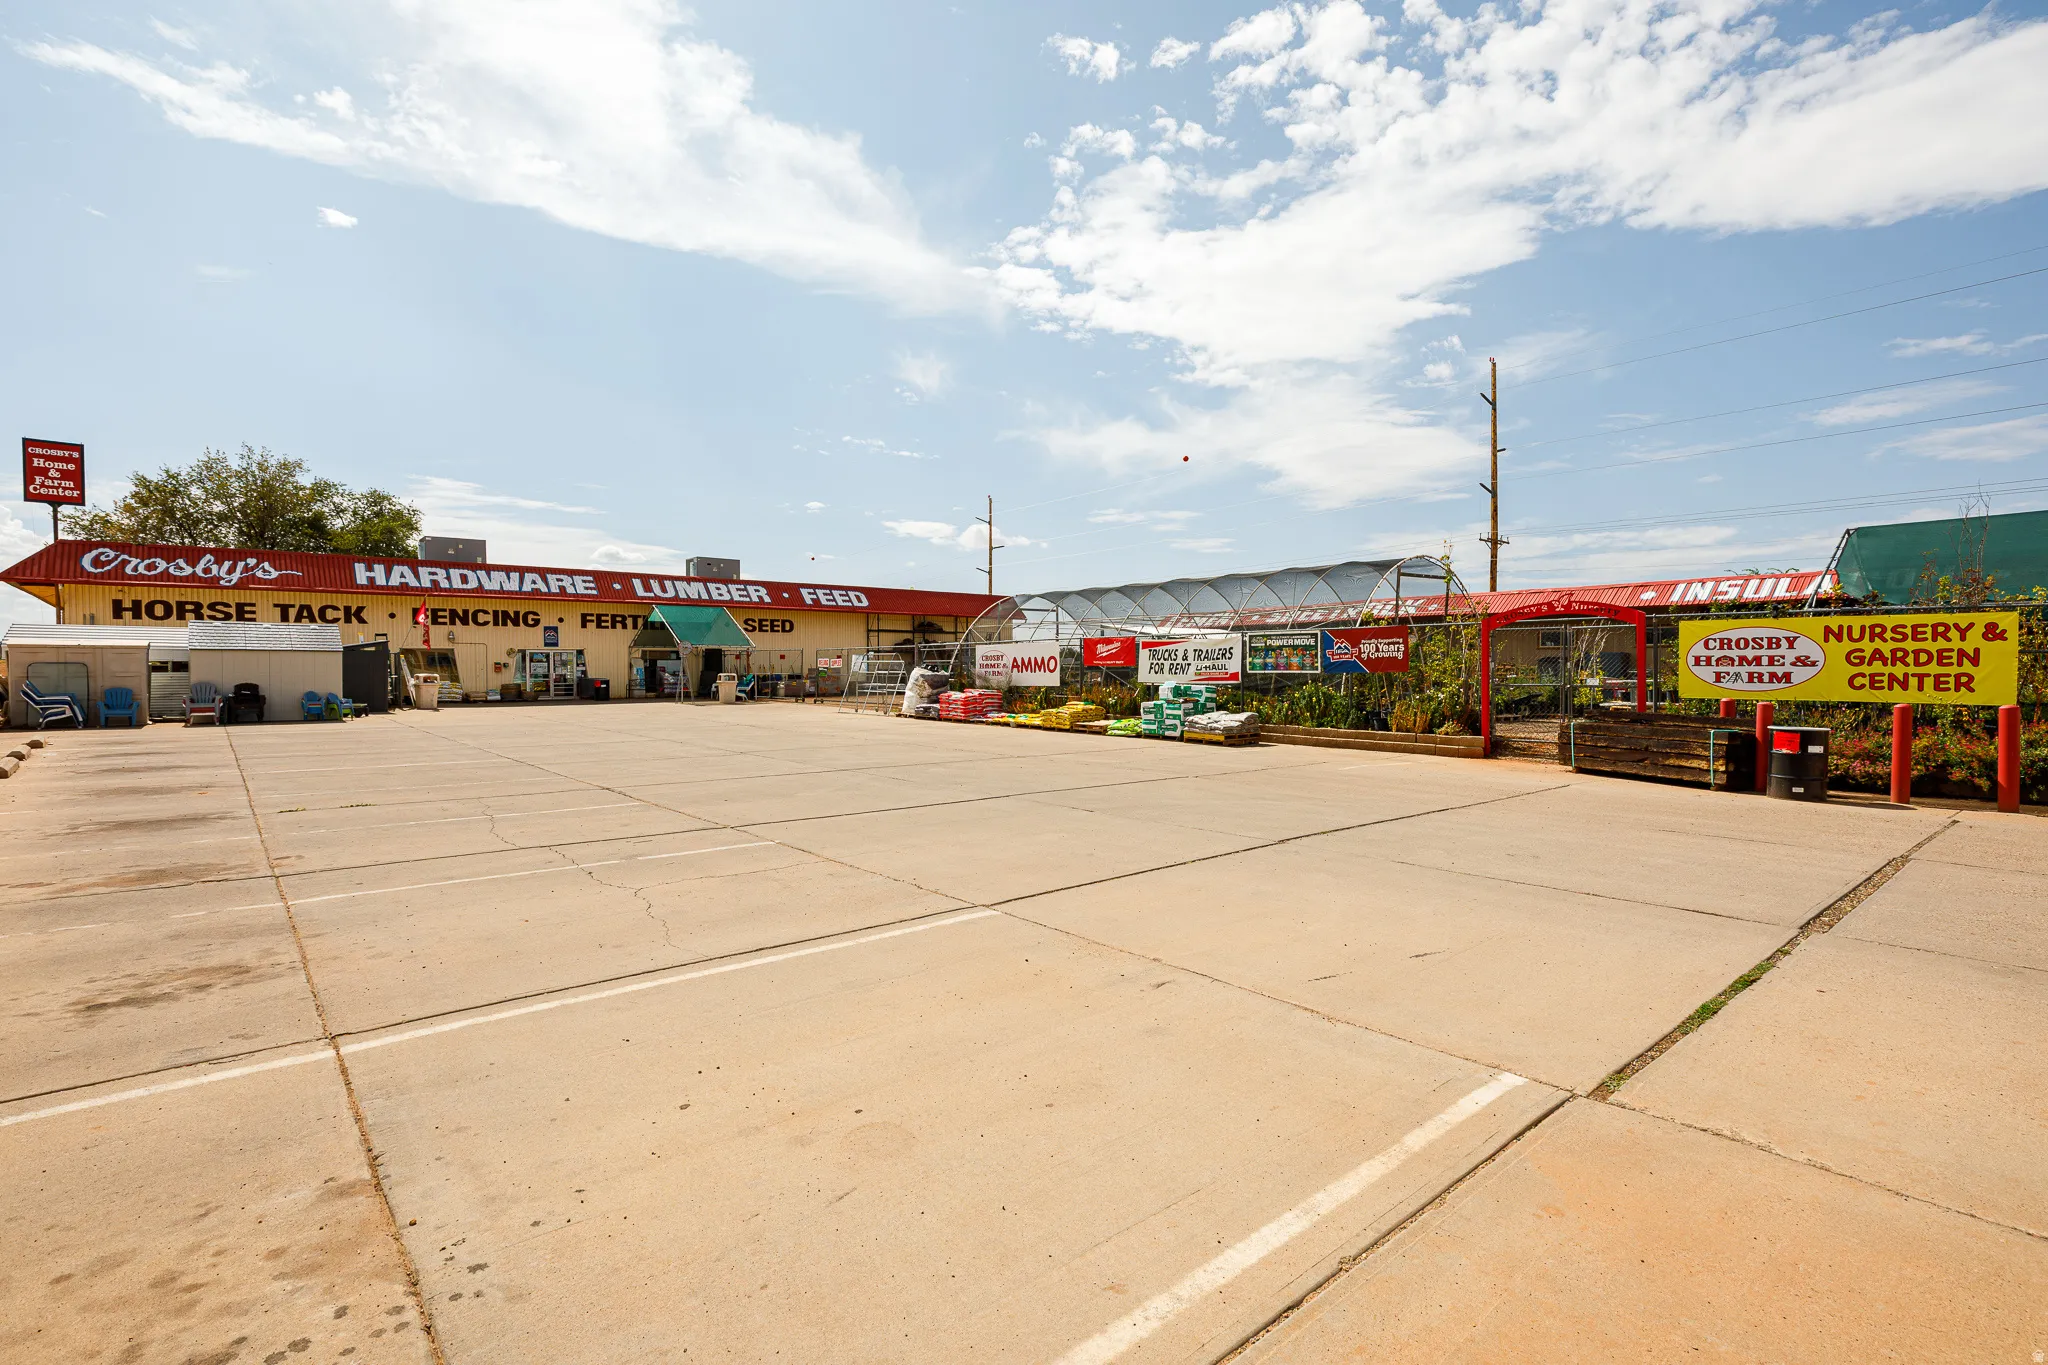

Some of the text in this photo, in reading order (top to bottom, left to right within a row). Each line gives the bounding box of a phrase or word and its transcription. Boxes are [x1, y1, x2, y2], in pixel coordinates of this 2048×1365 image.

[28, 447, 79, 458] CROSBY'S
[32, 457, 76, 470] Home
[48, 468, 61, 478] &
[34, 475, 75, 488] Farm
[29, 484, 81, 497] Center
[80, 548, 302, 586] Crosby's
[353, 563, 869, 607] HARDWARE LUMBER FEED
[112, 599, 256, 622] HORSE
[274, 603, 368, 625] TACK
[743, 618, 794, 633] SEED
[1496, 602, 1621, 623] CROSBY'S Nursery
[1823, 622, 2008, 643] NURSERY &
[1266, 638, 1293, 646] POWER
[1294, 638, 1316, 646] MOVE
[1360, 644, 1376, 653] 100
[1377, 643, 1405, 652] Years
[1703, 636, 1801, 650] CROSBY
[981, 654, 1005, 662] CROSBY
[1148, 646, 1234, 662] TRUCKS & TRAILERS
[1361, 652, 1368, 660] of
[1369, 651, 1403, 660] Growing
[1845, 647, 1980, 667] GARDEN
[1011, 655, 1058, 674] AMMO
[1692, 655, 1819, 667] HOME &
[1148, 661, 1165, 675] FOR
[1168, 662, 1192, 675] RENT
[1713, 671, 1794, 684] FARM
[1847, 672, 1976, 693] CENTER
